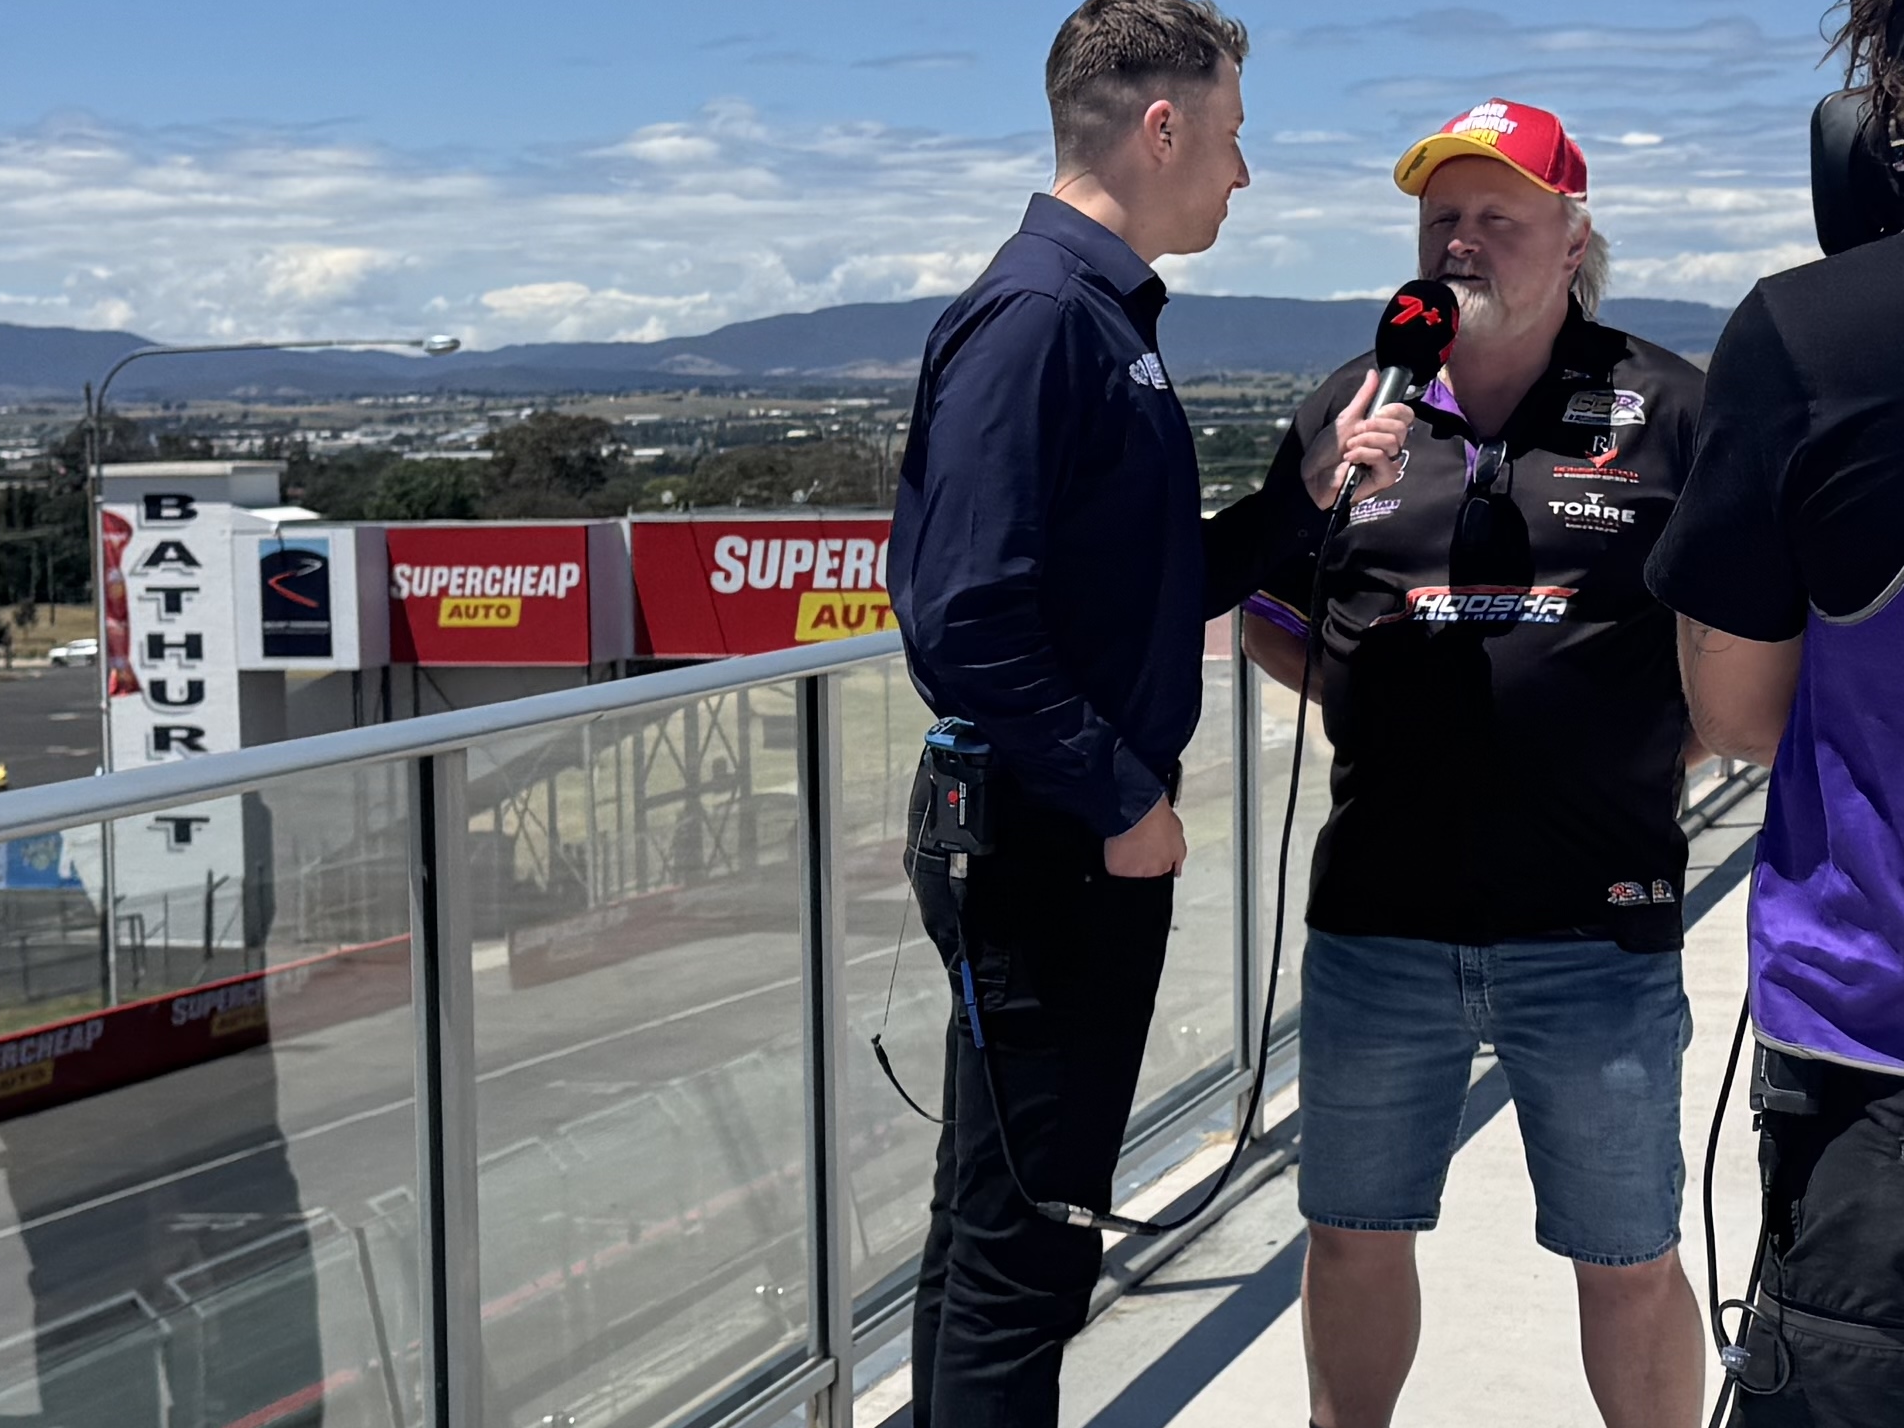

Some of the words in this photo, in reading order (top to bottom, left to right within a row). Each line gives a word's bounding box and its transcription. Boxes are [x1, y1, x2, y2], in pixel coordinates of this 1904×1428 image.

[1548, 501, 1636, 524] TORRE
[392, 562, 581, 601] SUPERCHEAP
[448, 600, 513, 623] AUTO
[137, 493, 209, 851] BATHURT
